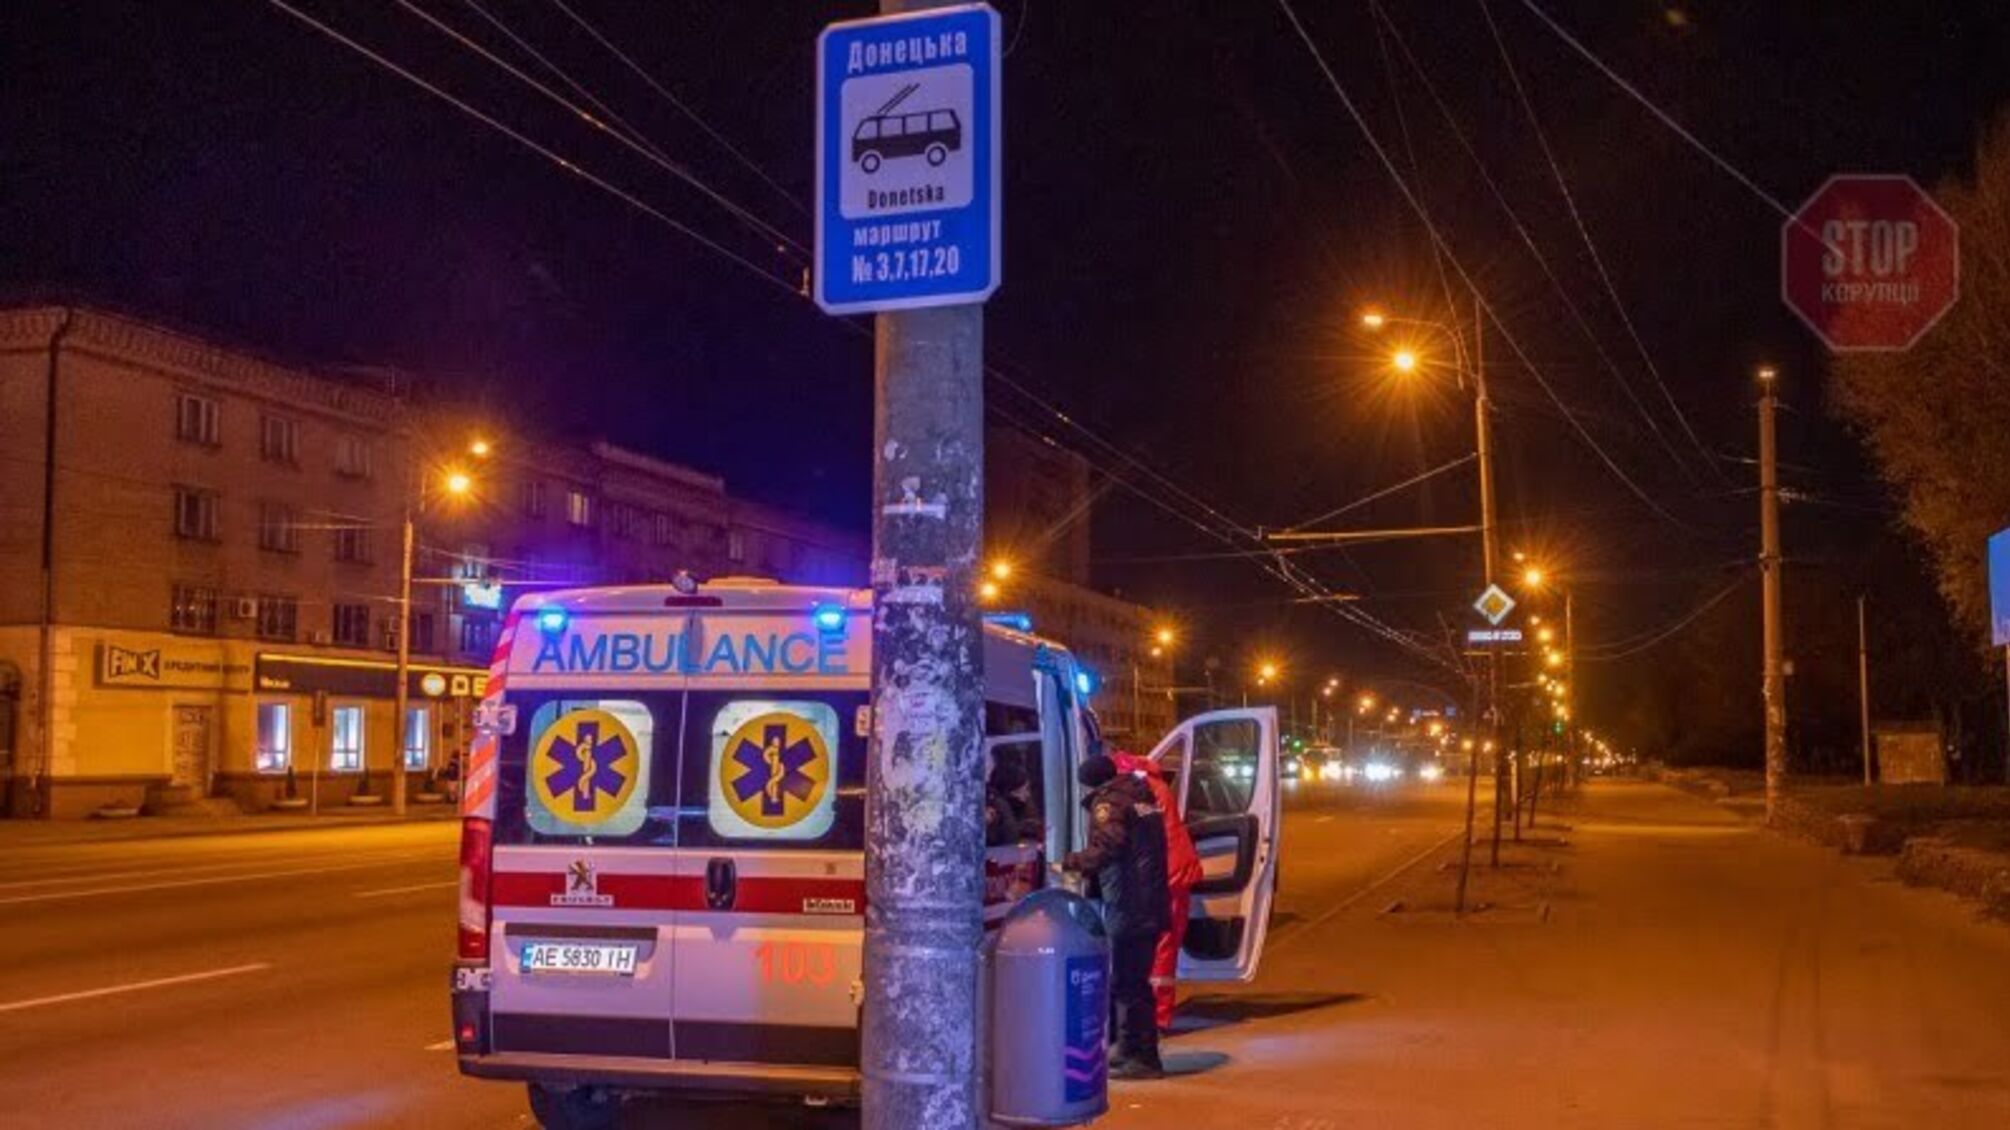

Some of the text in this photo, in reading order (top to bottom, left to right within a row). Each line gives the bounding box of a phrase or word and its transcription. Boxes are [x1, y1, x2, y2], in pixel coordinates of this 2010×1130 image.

[848, 31, 967, 74] Донецька
[868, 184, 945, 209] Donetska
[853, 219, 941, 247] маршрут
[852, 245, 959, 283] № 3,7,17,20
[532, 630, 850, 676] AMBULANCE
[533, 947, 559, 967] AE
[561, 947, 602, 967] 5830
